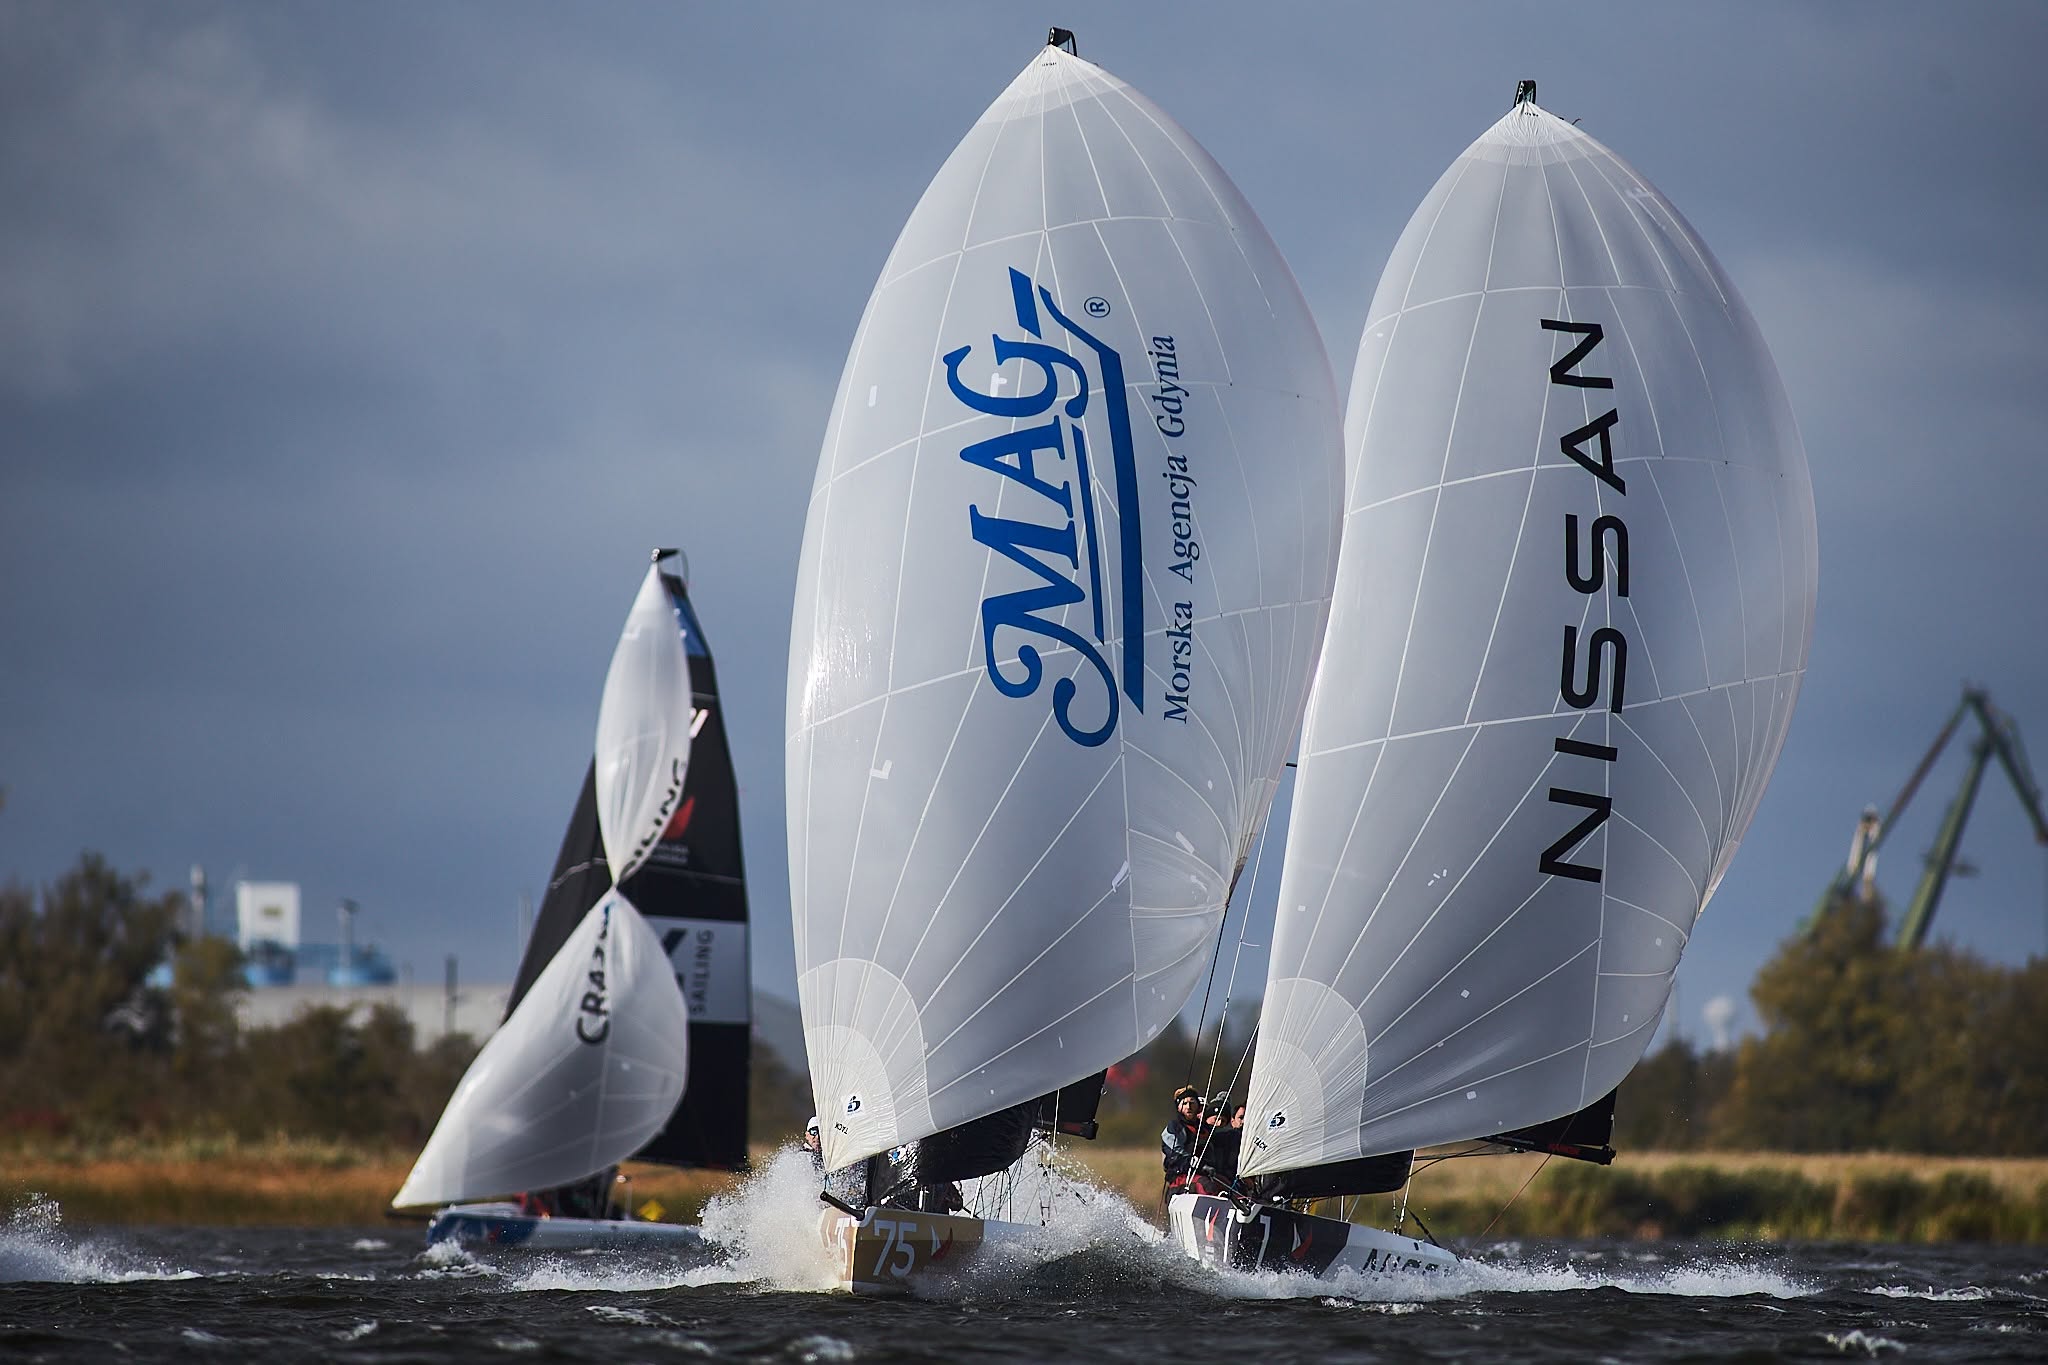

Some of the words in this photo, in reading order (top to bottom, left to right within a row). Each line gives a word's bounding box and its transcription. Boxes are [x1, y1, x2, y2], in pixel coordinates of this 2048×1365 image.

[1147, 334, 1190, 438] Gdynia
[942, 333, 1120, 748] MAG
[1162, 454, 1200, 585] Agencja
[1539, 318, 1630, 883] NISSAN
[1163, 600, 1194, 725] Morska
[689, 928, 715, 1018] SAILING
[1254, 1136, 1268, 1151] TACK
[872, 1218, 918, 1278] 75
